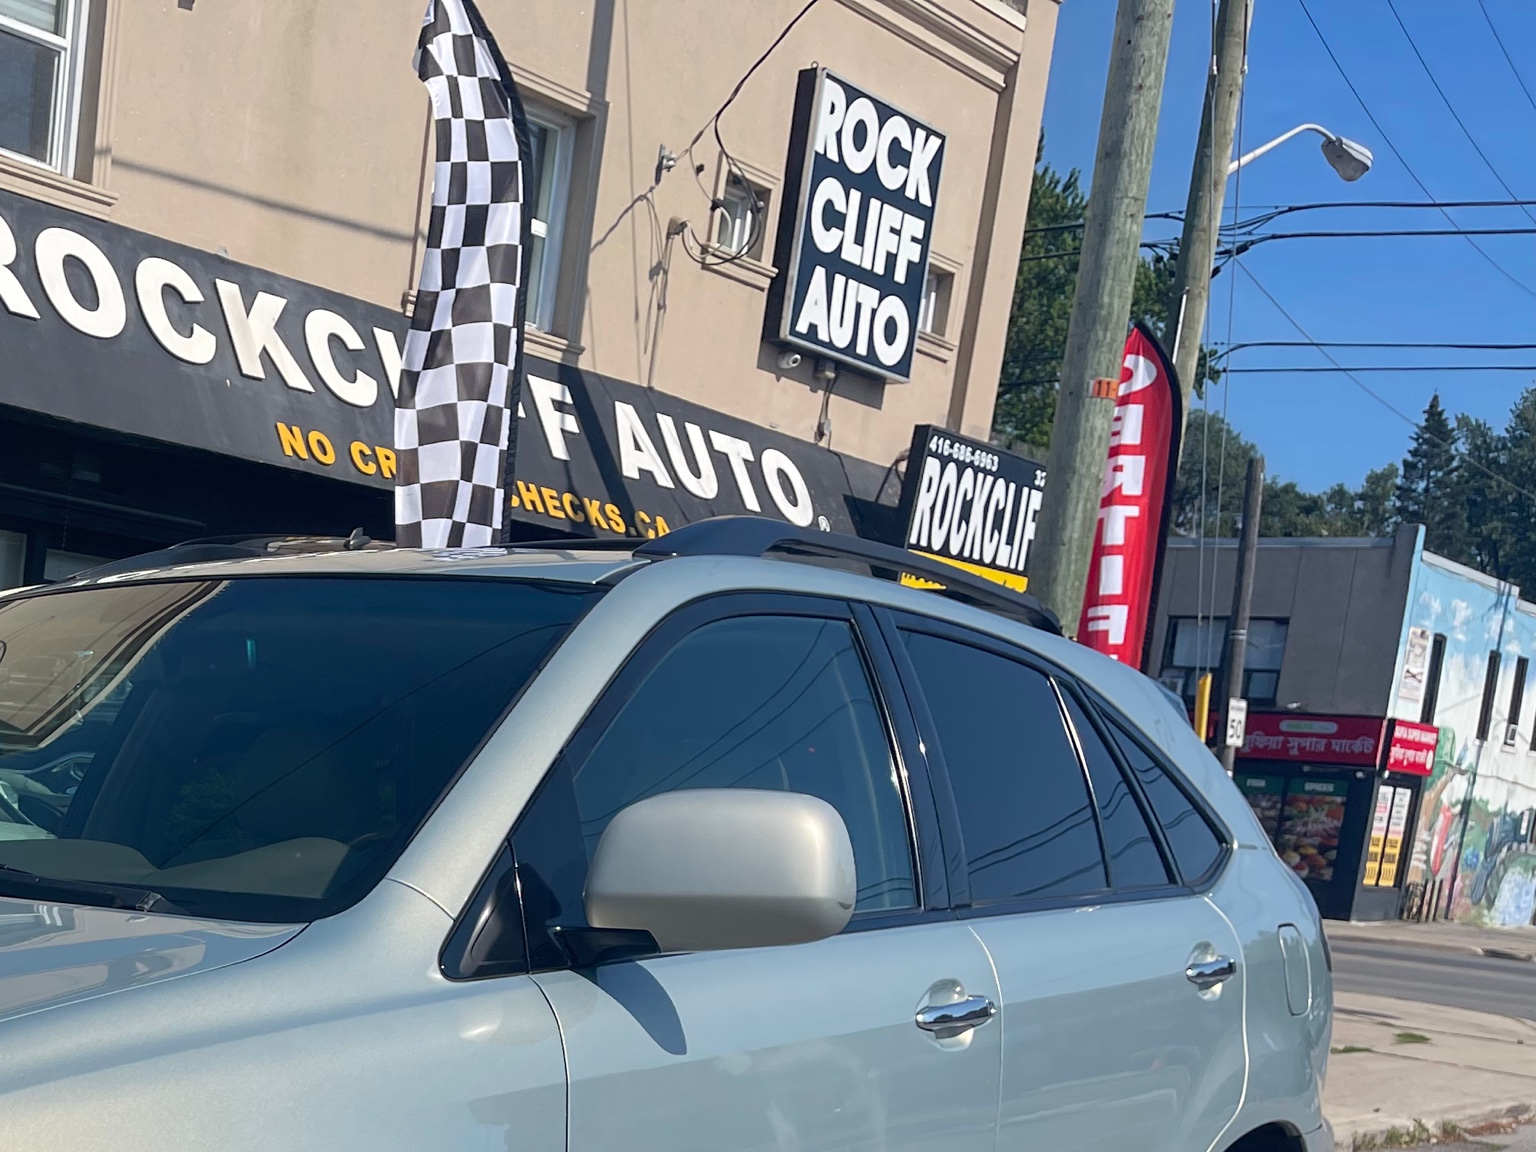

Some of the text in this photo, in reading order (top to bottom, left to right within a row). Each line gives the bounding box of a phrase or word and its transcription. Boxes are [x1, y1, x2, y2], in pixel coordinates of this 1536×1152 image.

[815, 78, 942, 207] ROCK
[811, 177, 925, 284] CLIFF
[795, 265, 910, 366] AUTO
[276, 422, 335, 475] NO
[615, 400, 813, 507] AUTO
[929, 435, 999, 472] 416-686-6963
[1229, 719, 1241, 738] 50
